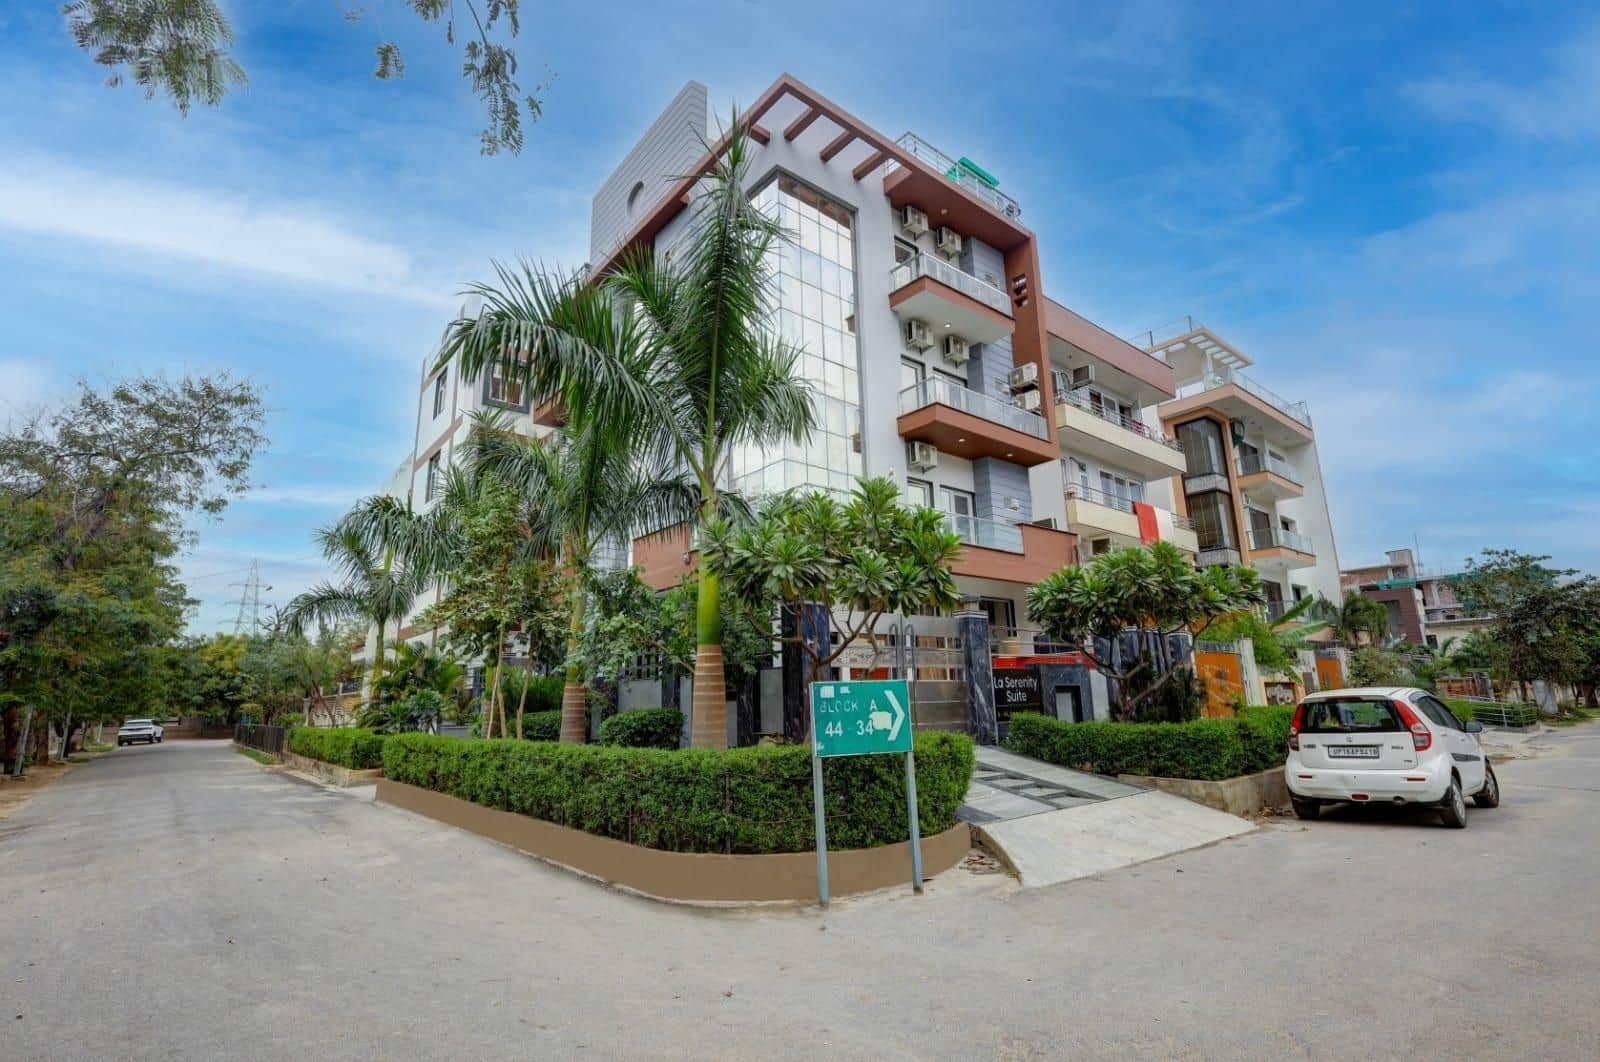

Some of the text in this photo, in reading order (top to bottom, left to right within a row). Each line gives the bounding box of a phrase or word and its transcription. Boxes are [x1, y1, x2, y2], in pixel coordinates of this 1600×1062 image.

[994, 676, 1037, 691] La Serenity
[1006, 690, 1027, 702] Suite
[869, 698, 878, 711] A
[824, 721, 843, 737] 44
